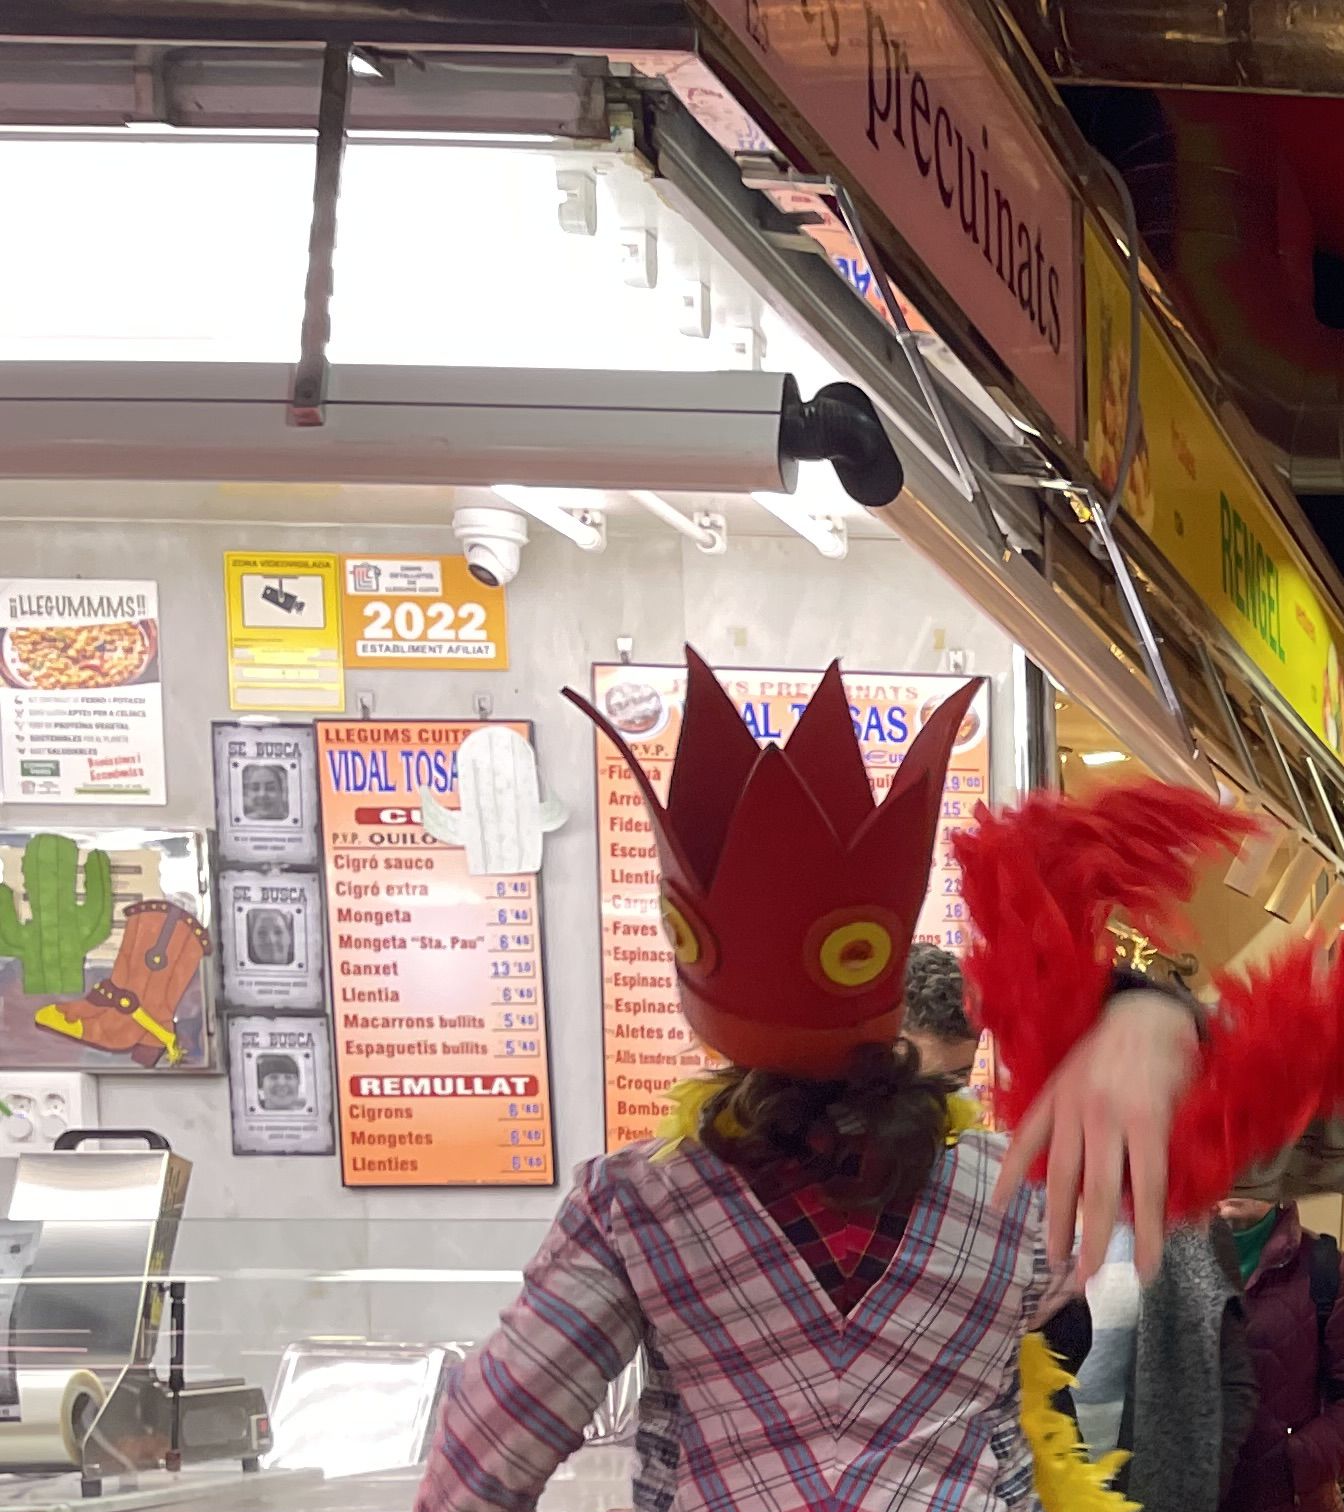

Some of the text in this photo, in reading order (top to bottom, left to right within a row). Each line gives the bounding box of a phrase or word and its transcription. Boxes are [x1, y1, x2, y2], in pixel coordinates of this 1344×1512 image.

[864, 2, 1061, 355] precuinats
[1220, 490, 1285, 664] RENGEL
[363, 601, 487, 640] 2022
[361, 644, 490, 656] ESTABLIMENT AFILIAT
[324, 728, 412, 744] LLEGUMS
[228, 741, 302, 758] SE BUSCA
[328, 750, 396, 792] VIDAL
[368, 832, 438, 845] QUILO
[334, 855, 434, 873] Cigró sauco
[233, 886, 308, 902] SE BUSCA
[335, 881, 380, 899] Cigró
[386, 883, 429, 897] extra
[337, 907, 411, 925] Mongeta
[612, 920, 658, 936] Faves
[339, 935, 407, 952] Mongeta
[613, 946, 674, 965] Espinacs
[340, 960, 398, 976] Ganxet
[613, 972, 672, 990] Espinacs
[342, 987, 400, 1003] Llentia
[343, 1014, 434, 1029] Macarrons
[439, 1014, 485, 1029] bullits
[615, 1023, 684, 1040] Aletes de
[345, 1039, 438, 1058] Espaguetis
[442, 1042, 488, 1056] bullits
[615, 1050, 636, 1064] Alls
[639, 1050, 677, 1065] tendres
[359, 1077, 531, 1096] REMULLAT
[350, 1104, 413, 1122] Cigrons
[351, 1131, 433, 1149] Mongetes
[352, 1156, 419, 1172] Llenties
